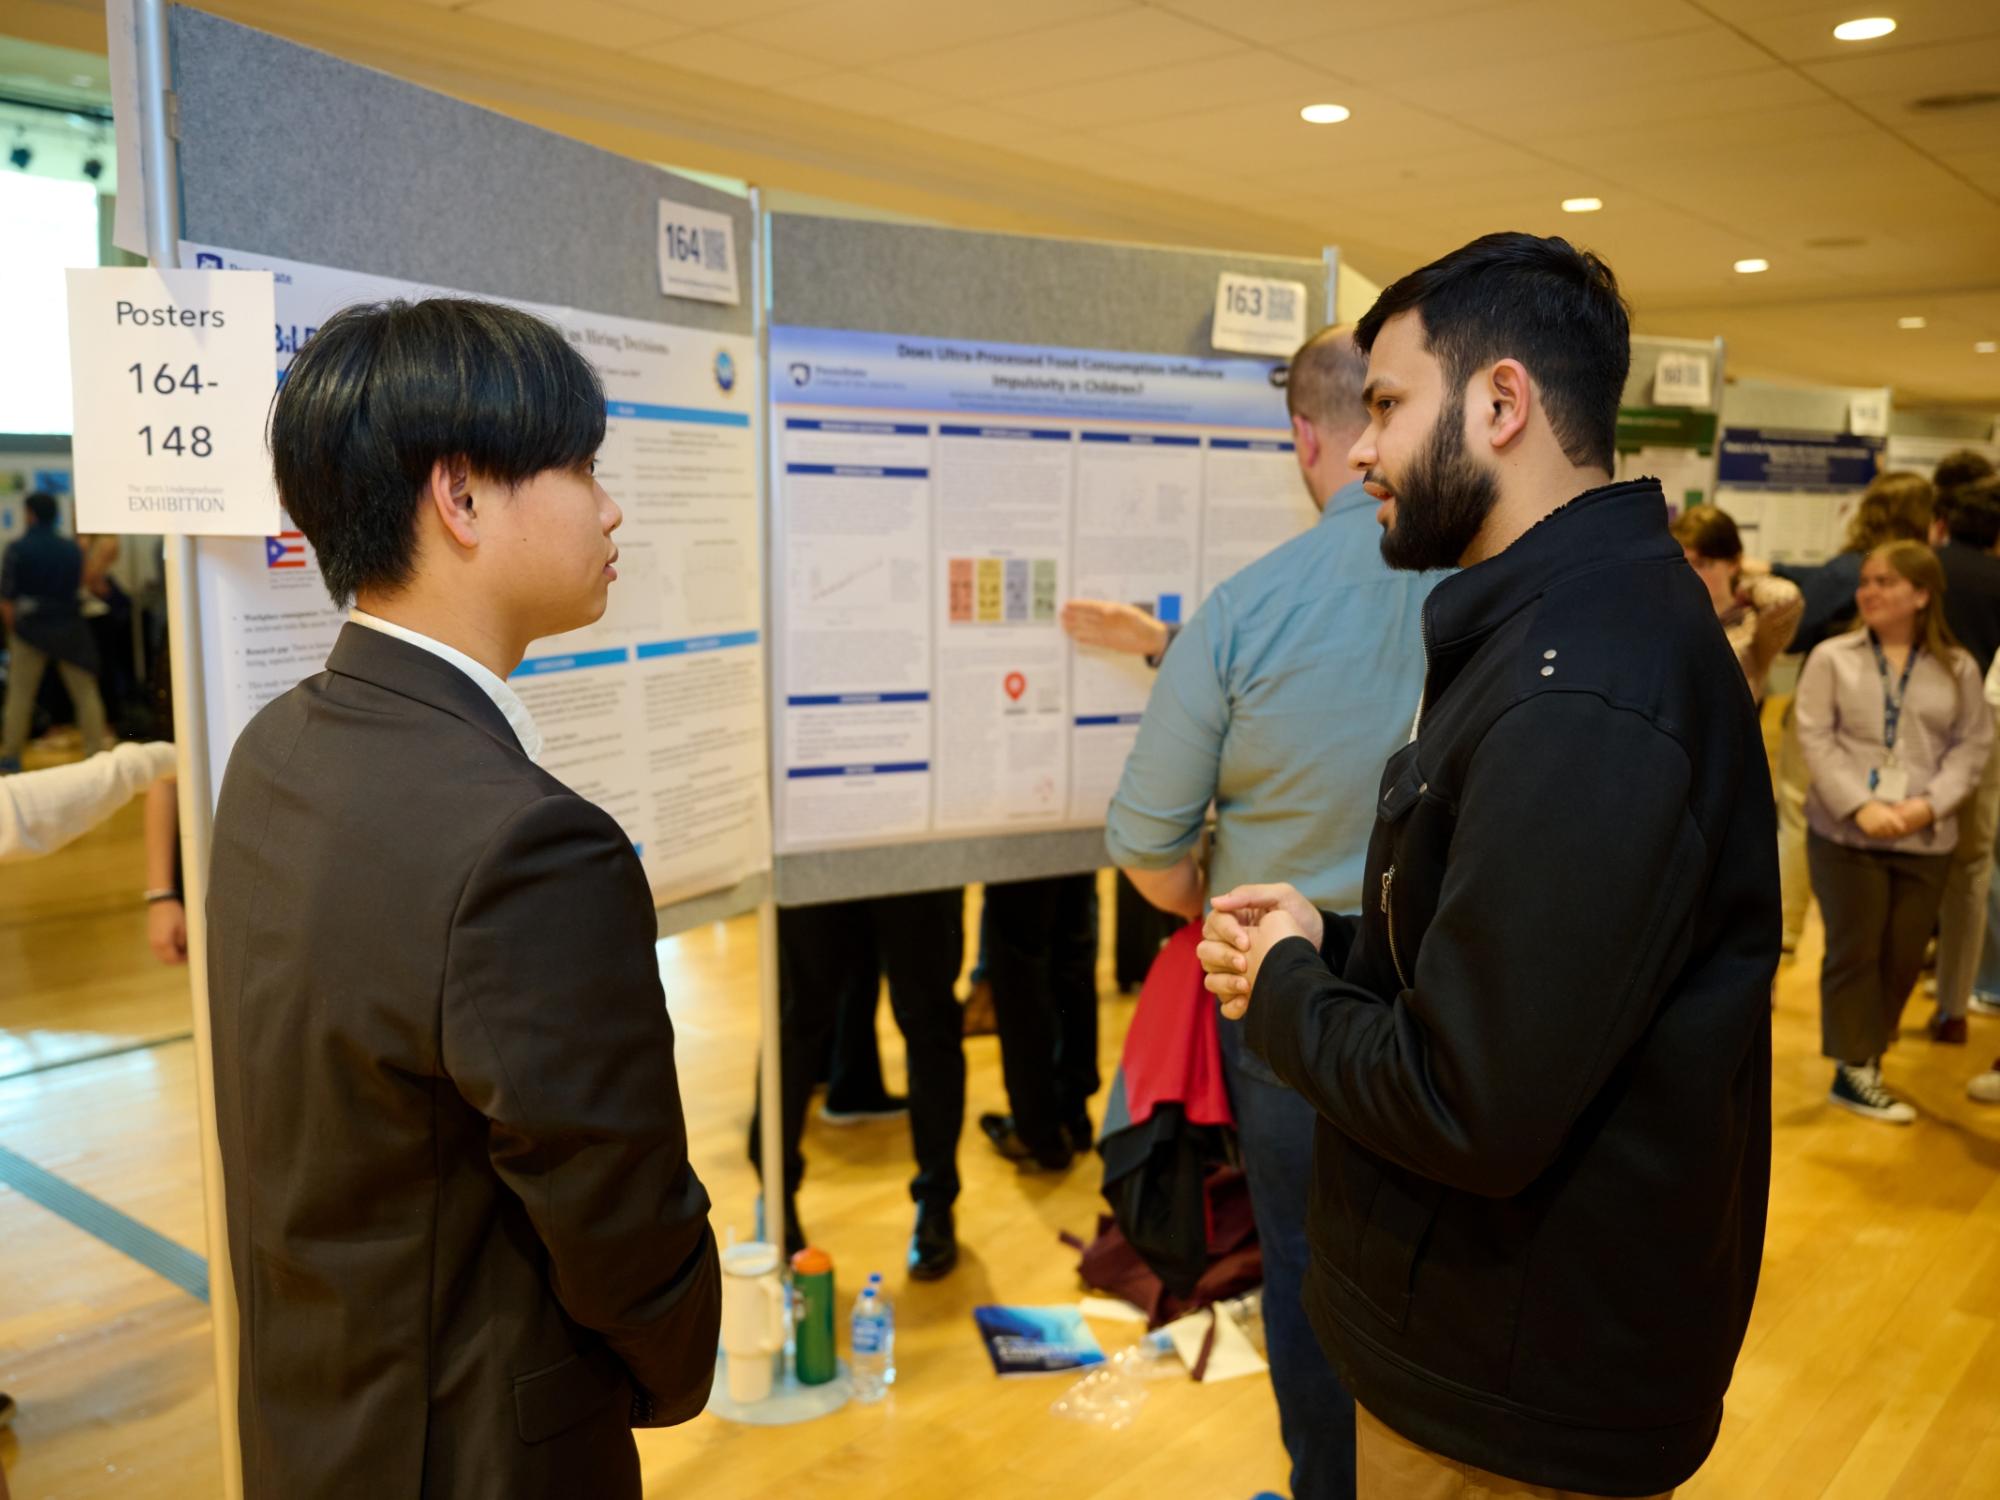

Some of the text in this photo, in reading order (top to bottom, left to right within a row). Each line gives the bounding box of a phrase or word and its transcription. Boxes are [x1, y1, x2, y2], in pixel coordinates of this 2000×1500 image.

[666, 223, 700, 264] 164
[116, 301, 225, 328] Posters
[1226, 284, 1262, 316] 163
[897, 344, 1225, 377] Does Ultra-Processed Food Consumption Influence
[128, 363, 219, 395] 164-
[992, 375, 1145, 395] Impulsivity in Children?
[138, 426, 213, 457] 148
[128, 496, 225, 512] EXHIBITION
